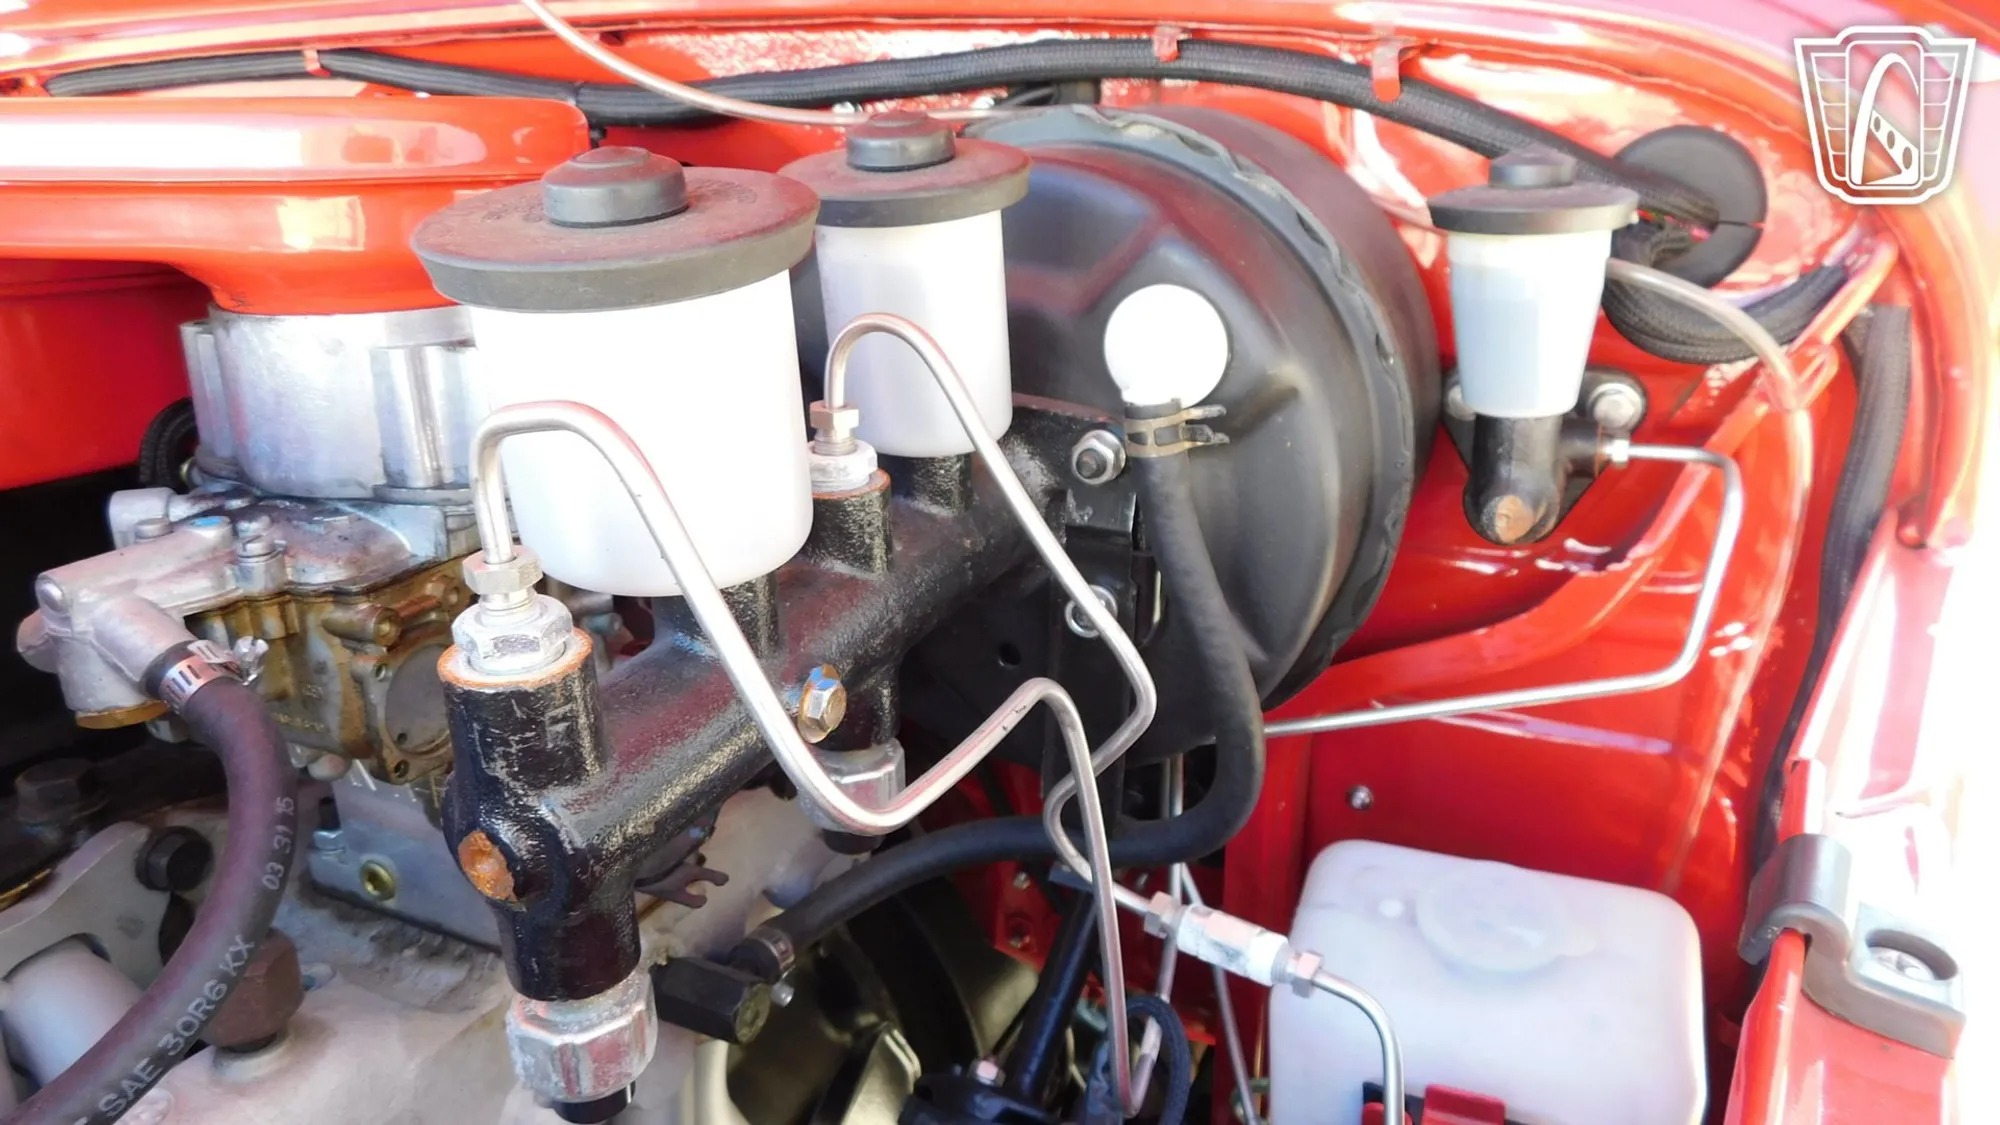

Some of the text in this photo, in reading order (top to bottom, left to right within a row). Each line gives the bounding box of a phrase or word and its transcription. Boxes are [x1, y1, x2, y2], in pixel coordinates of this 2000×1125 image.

[275, 796, 295, 816] 15
[273, 824, 294, 854] 31
[261, 861, 285, 890] 03
[218, 934, 255, 977] KX
[98, 1057, 164, 1117] SAE
